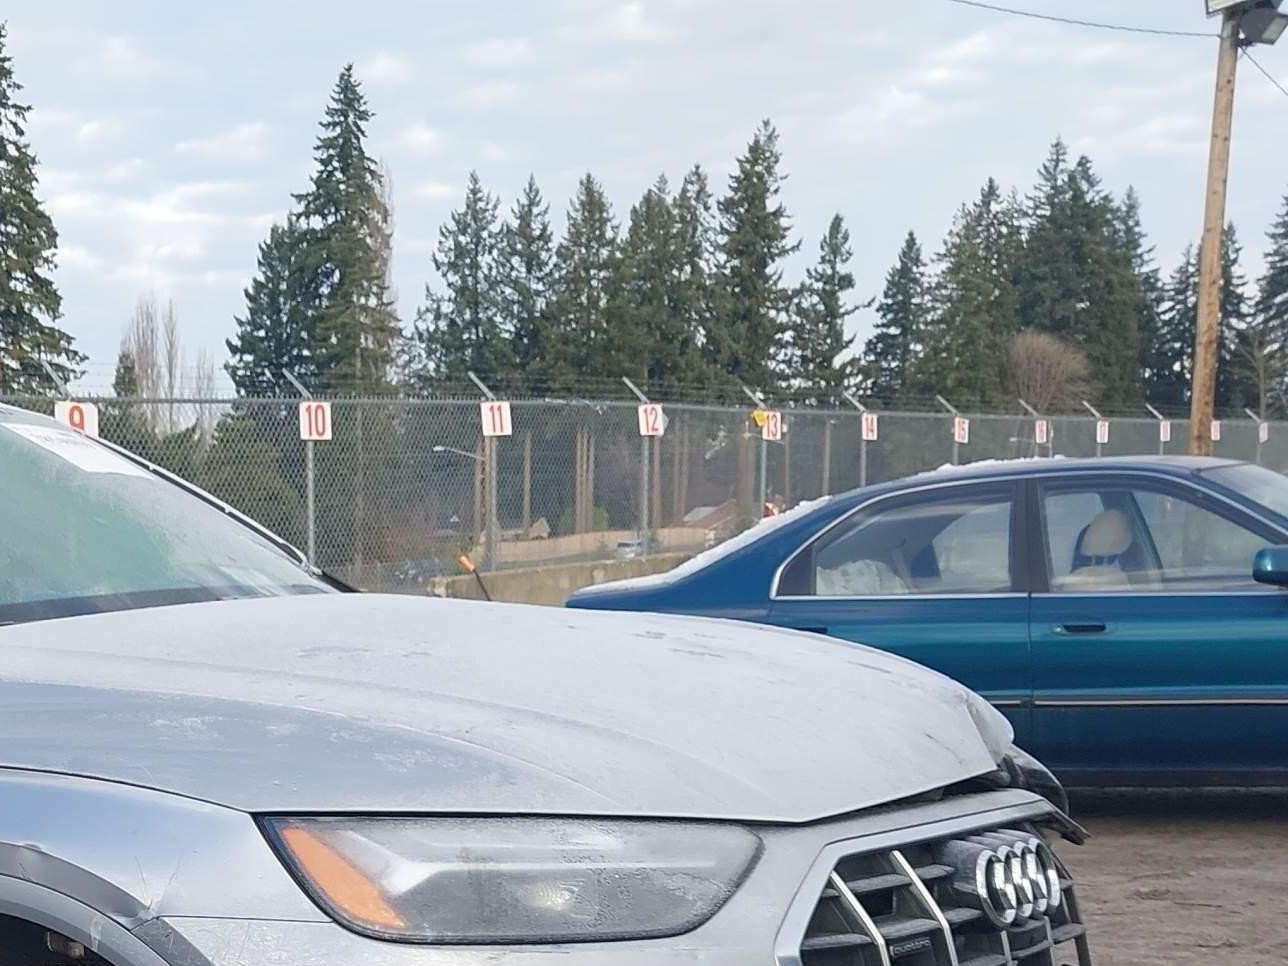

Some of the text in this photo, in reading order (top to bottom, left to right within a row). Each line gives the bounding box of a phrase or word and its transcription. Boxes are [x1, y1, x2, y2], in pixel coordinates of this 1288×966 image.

[68, 405, 85, 431] 9
[306, 403, 327, 437] 10
[489, 404, 505, 433] 11
[643, 407, 659, 433] 12
[765, 413, 778, 438] 13
